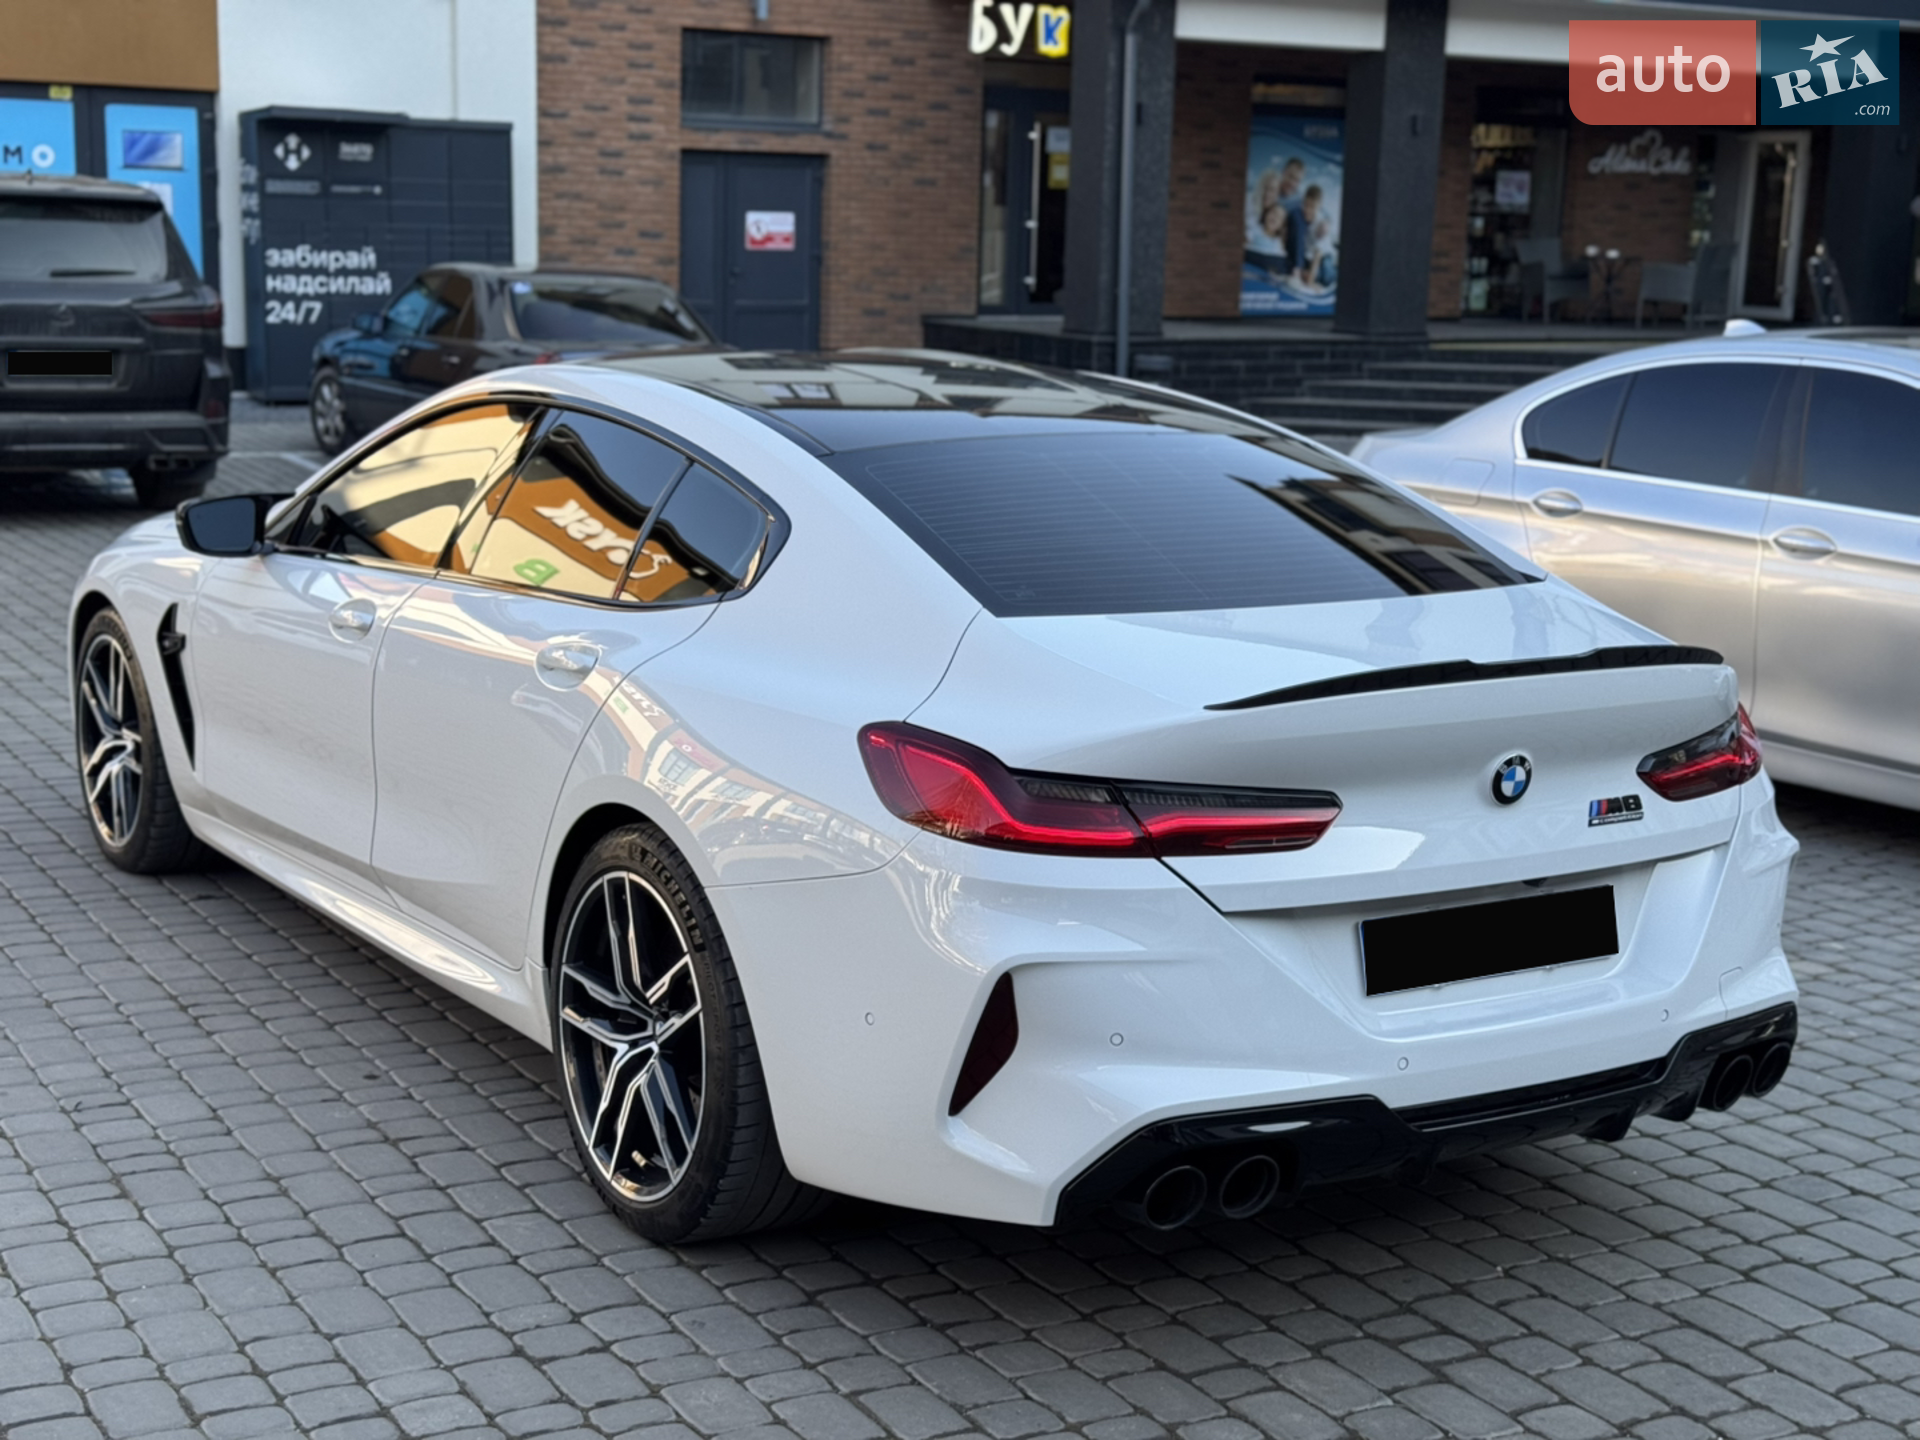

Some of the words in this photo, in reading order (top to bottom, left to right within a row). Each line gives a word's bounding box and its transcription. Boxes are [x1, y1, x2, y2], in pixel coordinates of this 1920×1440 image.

[265, 243, 377, 273] забирай
[265, 271, 392, 297] надсилай
[265, 300, 324, 325] 24/7
[643, 854, 704, 947] MICHELIN
